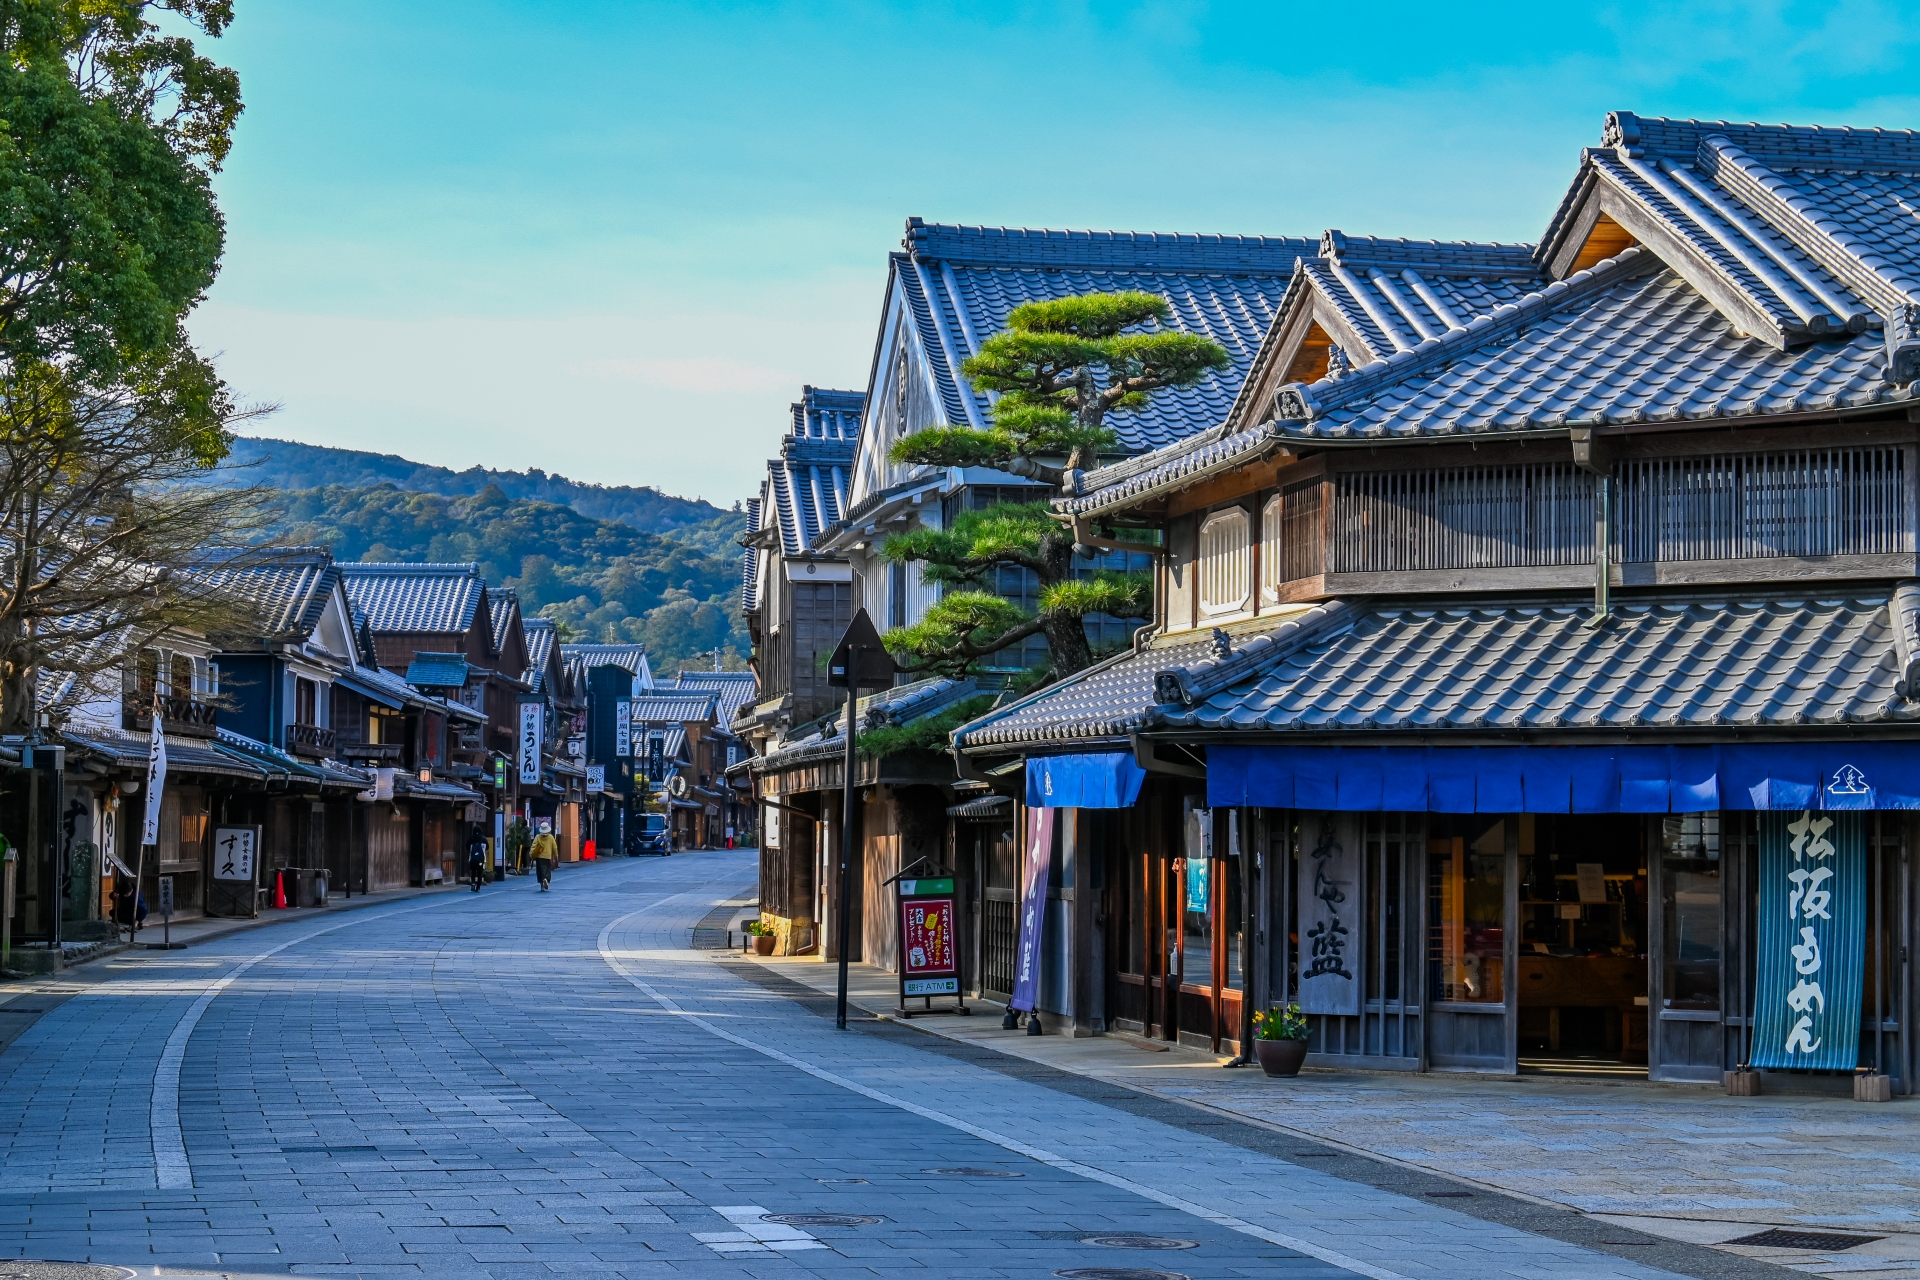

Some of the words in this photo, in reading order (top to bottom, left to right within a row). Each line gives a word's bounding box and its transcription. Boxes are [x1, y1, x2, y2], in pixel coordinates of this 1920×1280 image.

[908, 983, 924, 992] 銀行
[925, 982, 945, 991] ATM
[1785, 810, 1835, 1054] 松阪もめん
